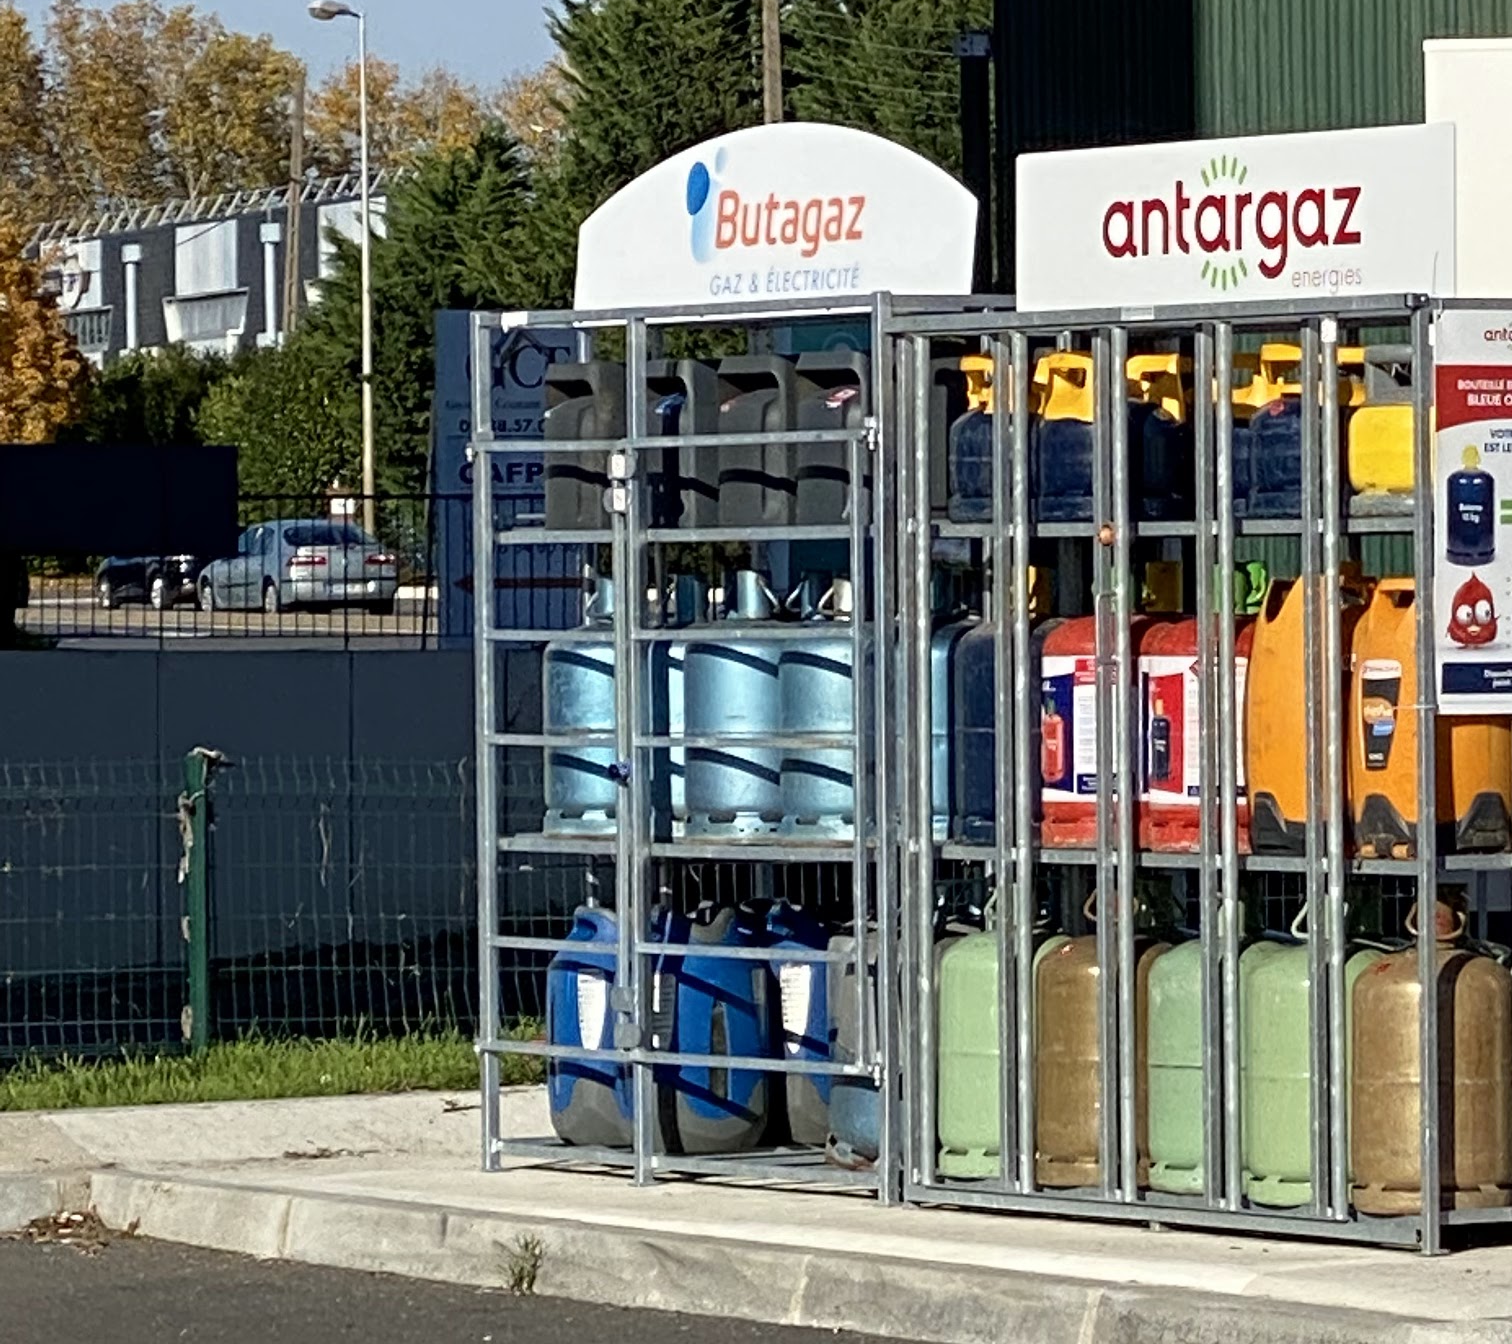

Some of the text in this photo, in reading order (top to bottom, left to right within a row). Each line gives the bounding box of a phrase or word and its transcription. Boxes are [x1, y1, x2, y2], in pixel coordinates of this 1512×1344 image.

[715, 190, 866, 258] Butagaz
[1103, 180, 1362, 279] antargaz
[710, 264, 861, 296] GAZ & ÉLECTRICITÉ
[1291, 266, 1362, 295] energies
[1467, 394, 1502, 407] BLEUE
[1484, 442, 1500, 453] EST
[1502, 442, 1512, 453] LE
